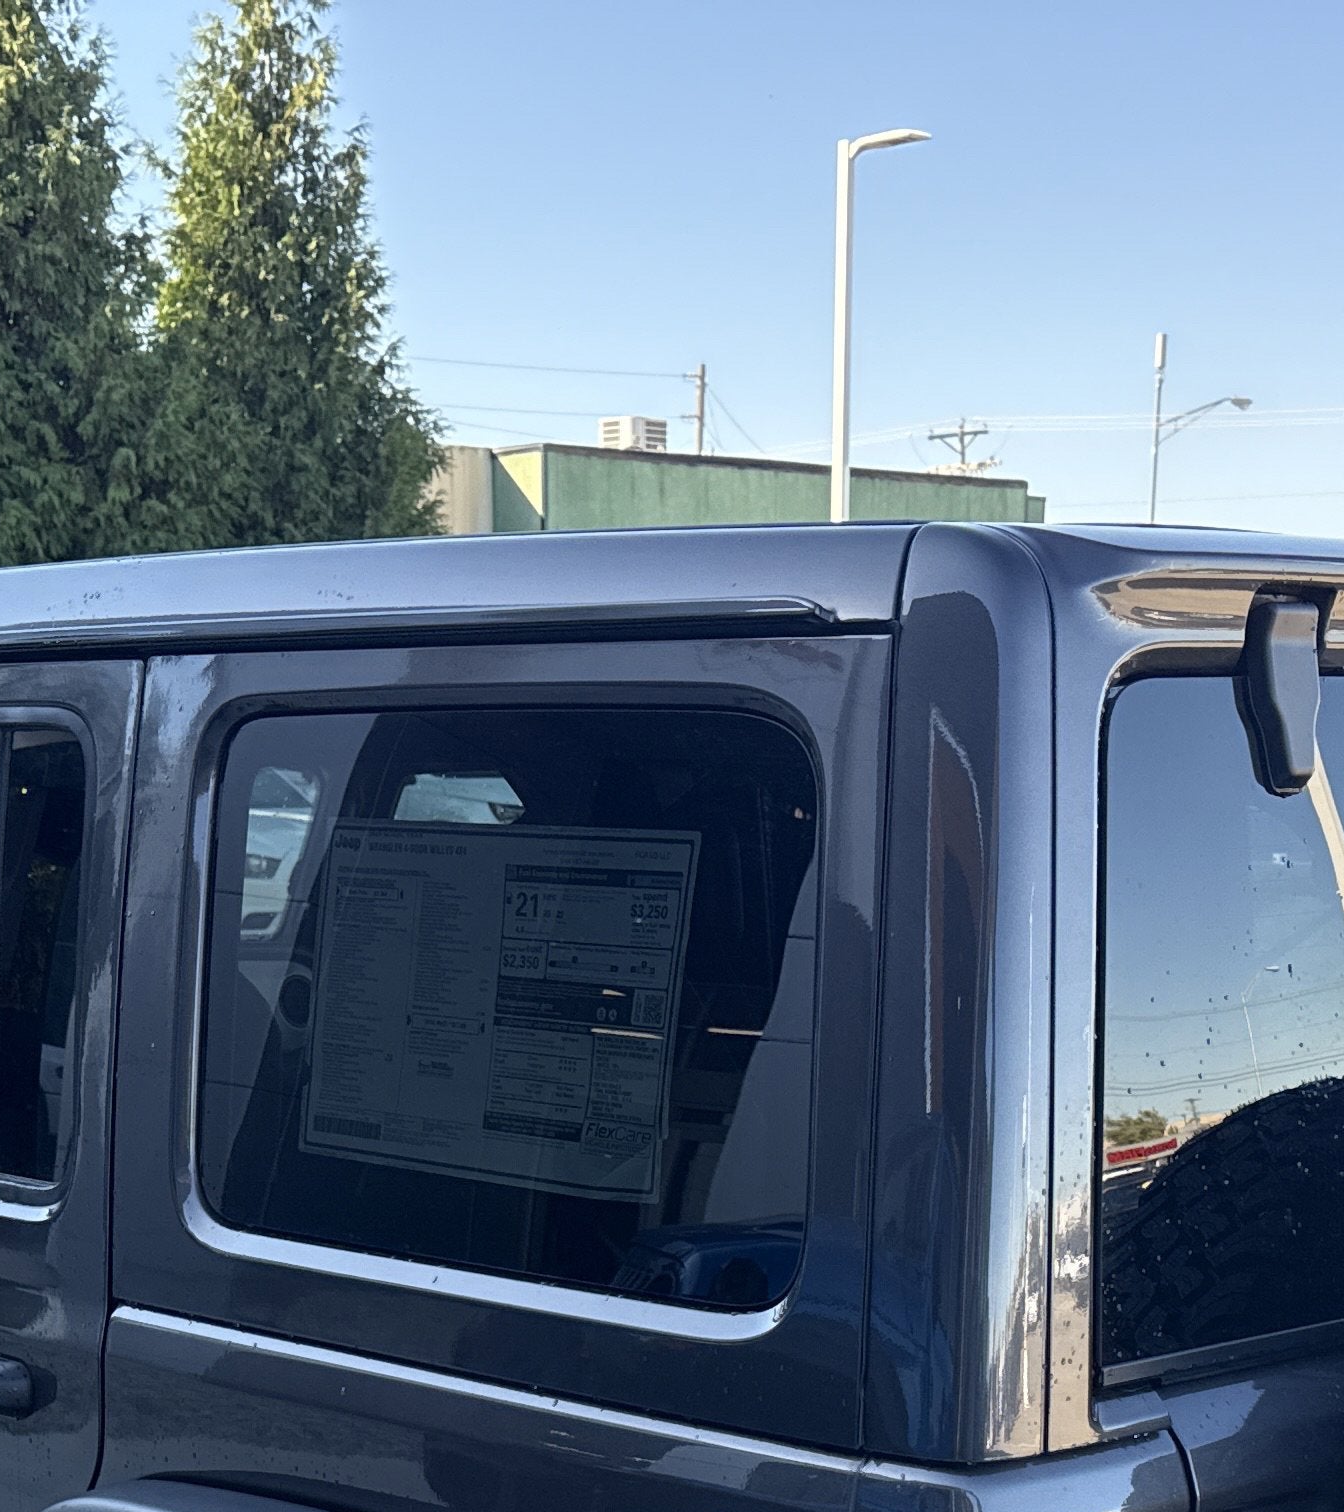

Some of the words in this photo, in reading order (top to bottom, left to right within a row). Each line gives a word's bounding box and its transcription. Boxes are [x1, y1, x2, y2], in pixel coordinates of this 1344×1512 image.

[335, 834, 361, 853] Jeep
[515, 892, 539, 917] 21
[630, 904, 668, 920] $3,250
[503, 954, 540, 969] $2,350
[585, 1122, 652, 1145] FlexCare
